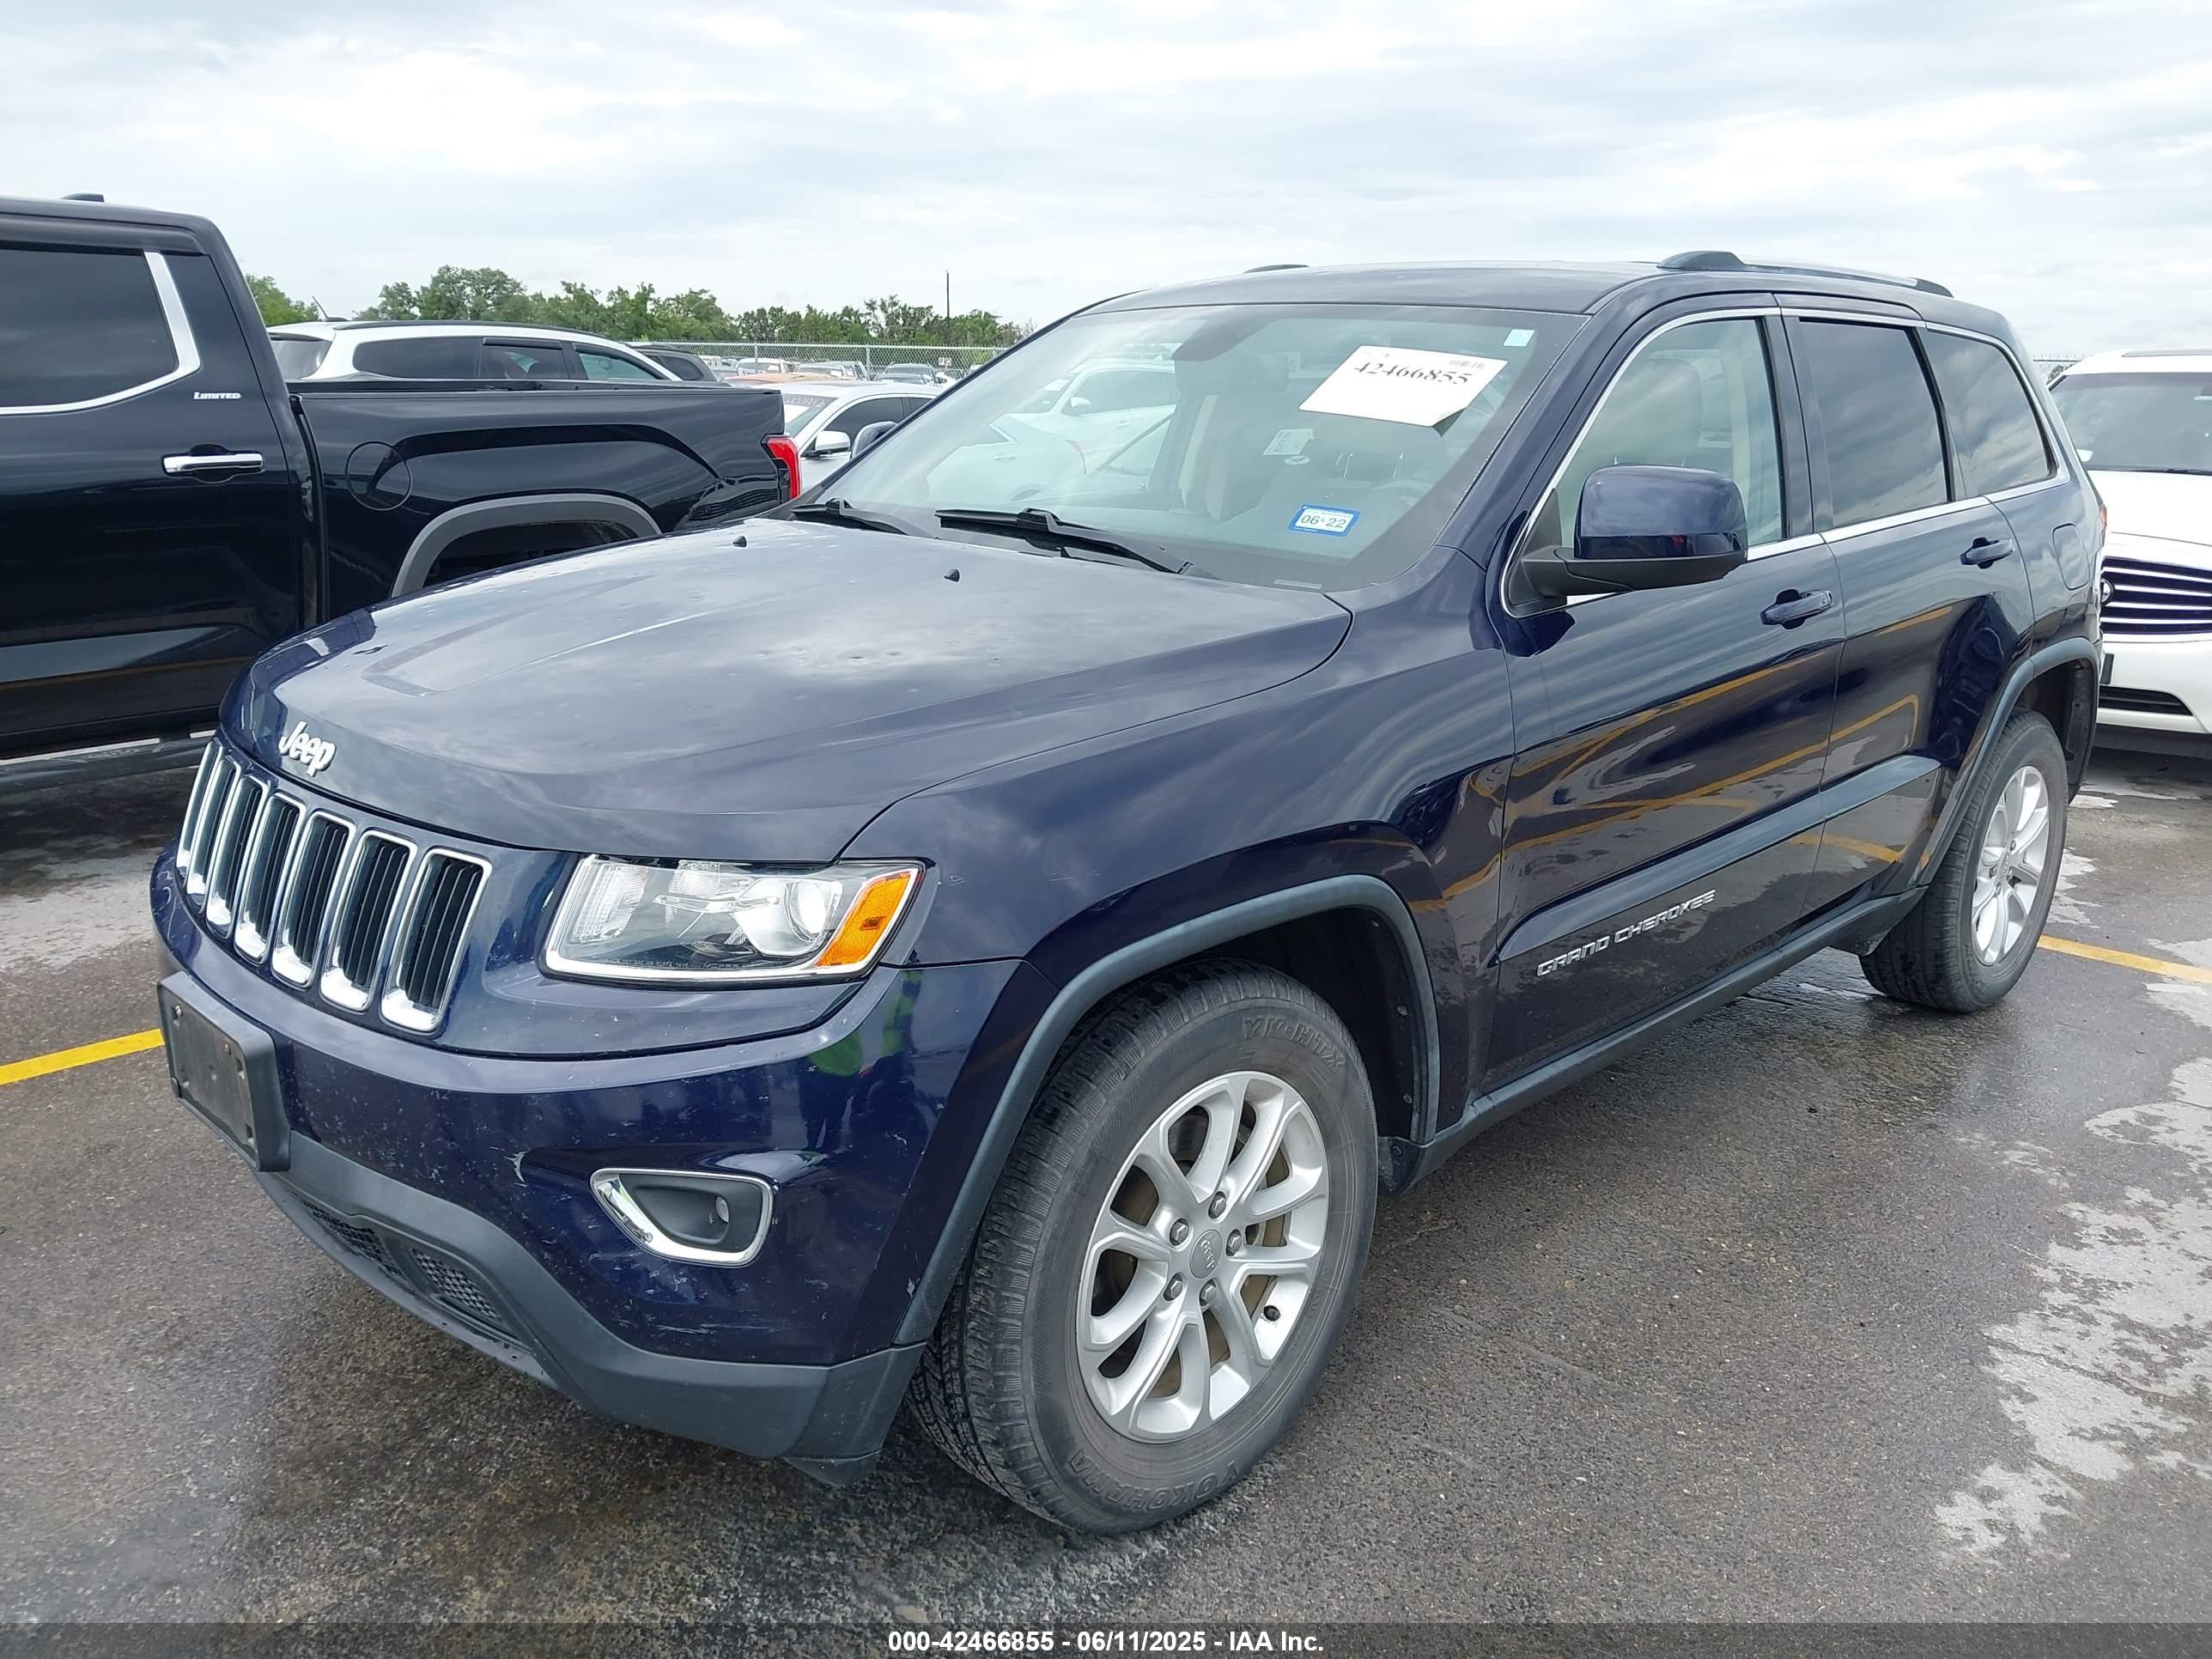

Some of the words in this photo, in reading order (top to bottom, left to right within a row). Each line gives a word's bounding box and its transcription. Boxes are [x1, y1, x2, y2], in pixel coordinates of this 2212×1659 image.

[1353, 362, 1473, 385] 42466855
[1301, 514, 1320, 525] 06
[1325, 518, 1347, 528] 22
[278, 720, 337, 777] Jeep
[1537, 936, 1610, 976] GRAND
[1613, 890, 1716, 944] CHEROKEE
[1071, 1449, 1241, 1510] YOKOHAMA
